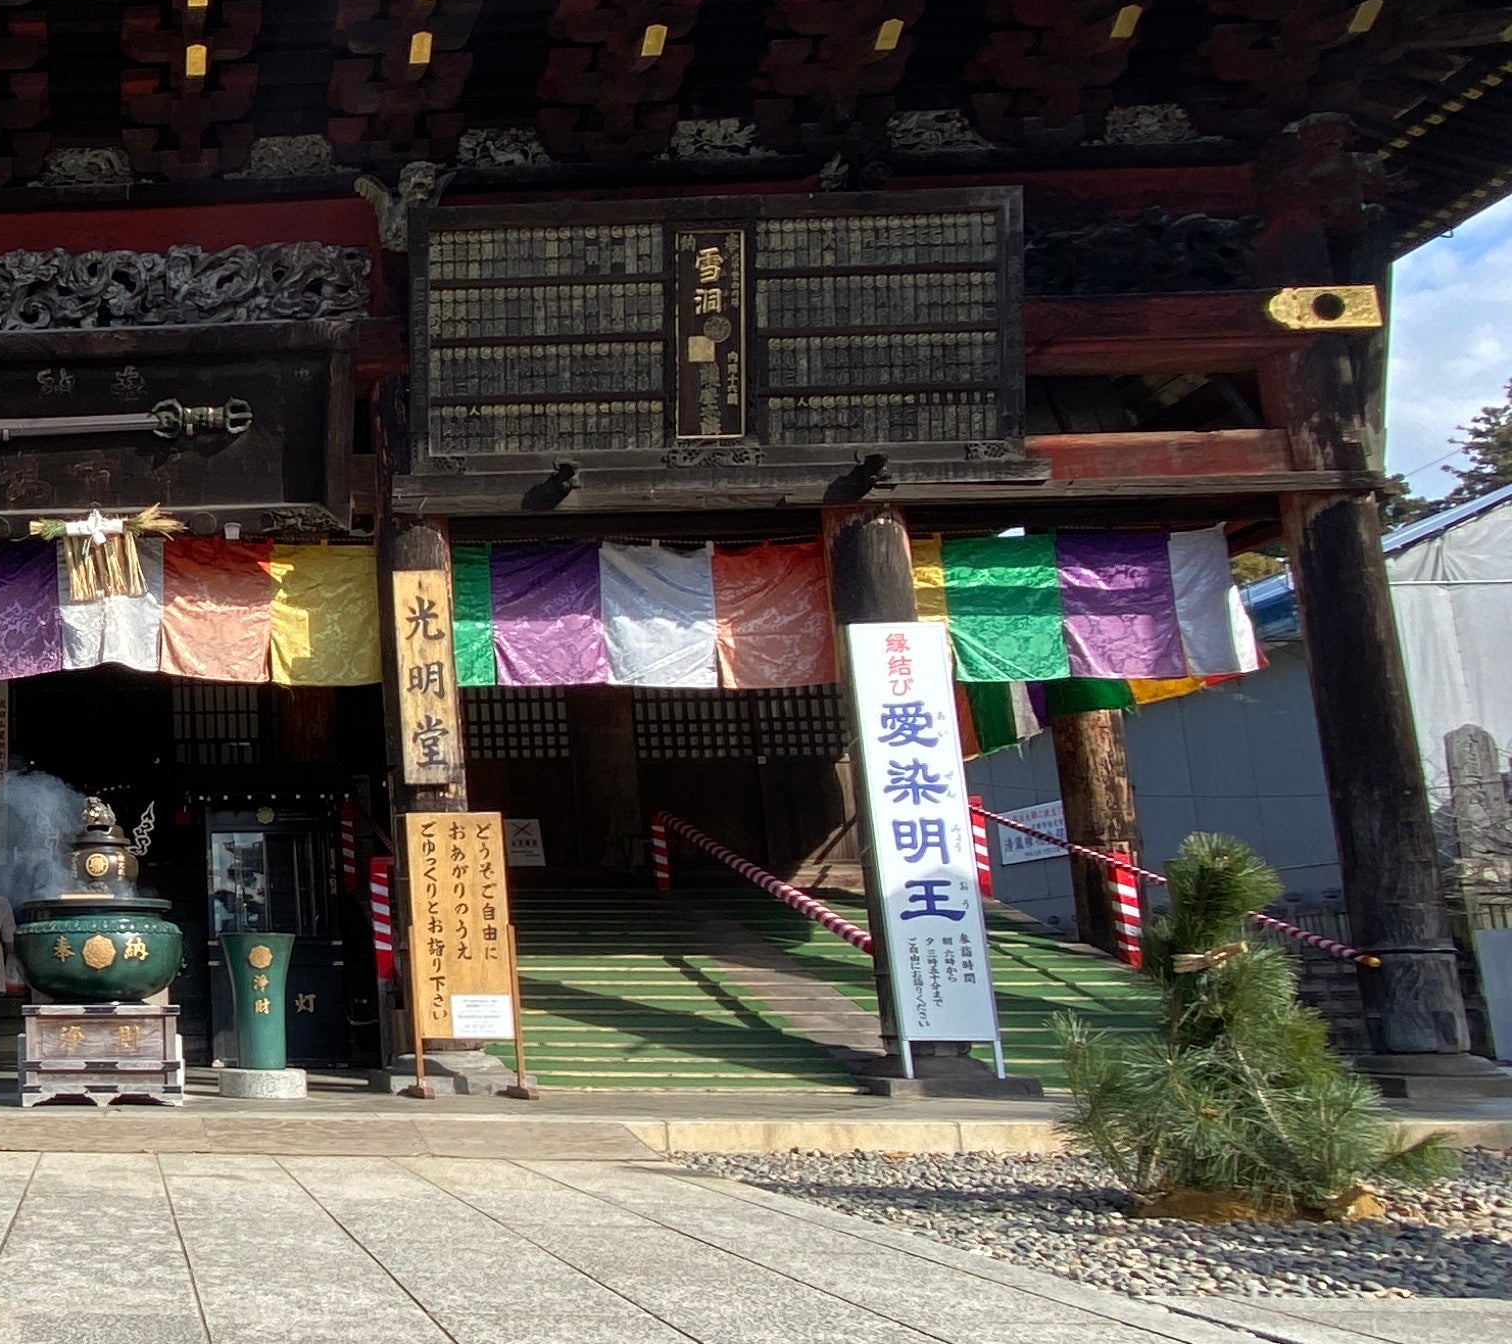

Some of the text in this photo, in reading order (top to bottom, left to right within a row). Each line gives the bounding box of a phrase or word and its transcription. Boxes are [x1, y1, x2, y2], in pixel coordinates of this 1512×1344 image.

[694, 246, 724, 315] 雪洞
[405, 595, 449, 768] 光明堂
[884, 633, 914, 696] 縁結び
[877, 700, 967, 922] 愛染明王
[420, 821, 448, 1021] ごゆっくりとお詣り下さい
[448, 821, 472, 960] おあがりのうえ
[476, 822, 498, 960] どうぞご自由に
